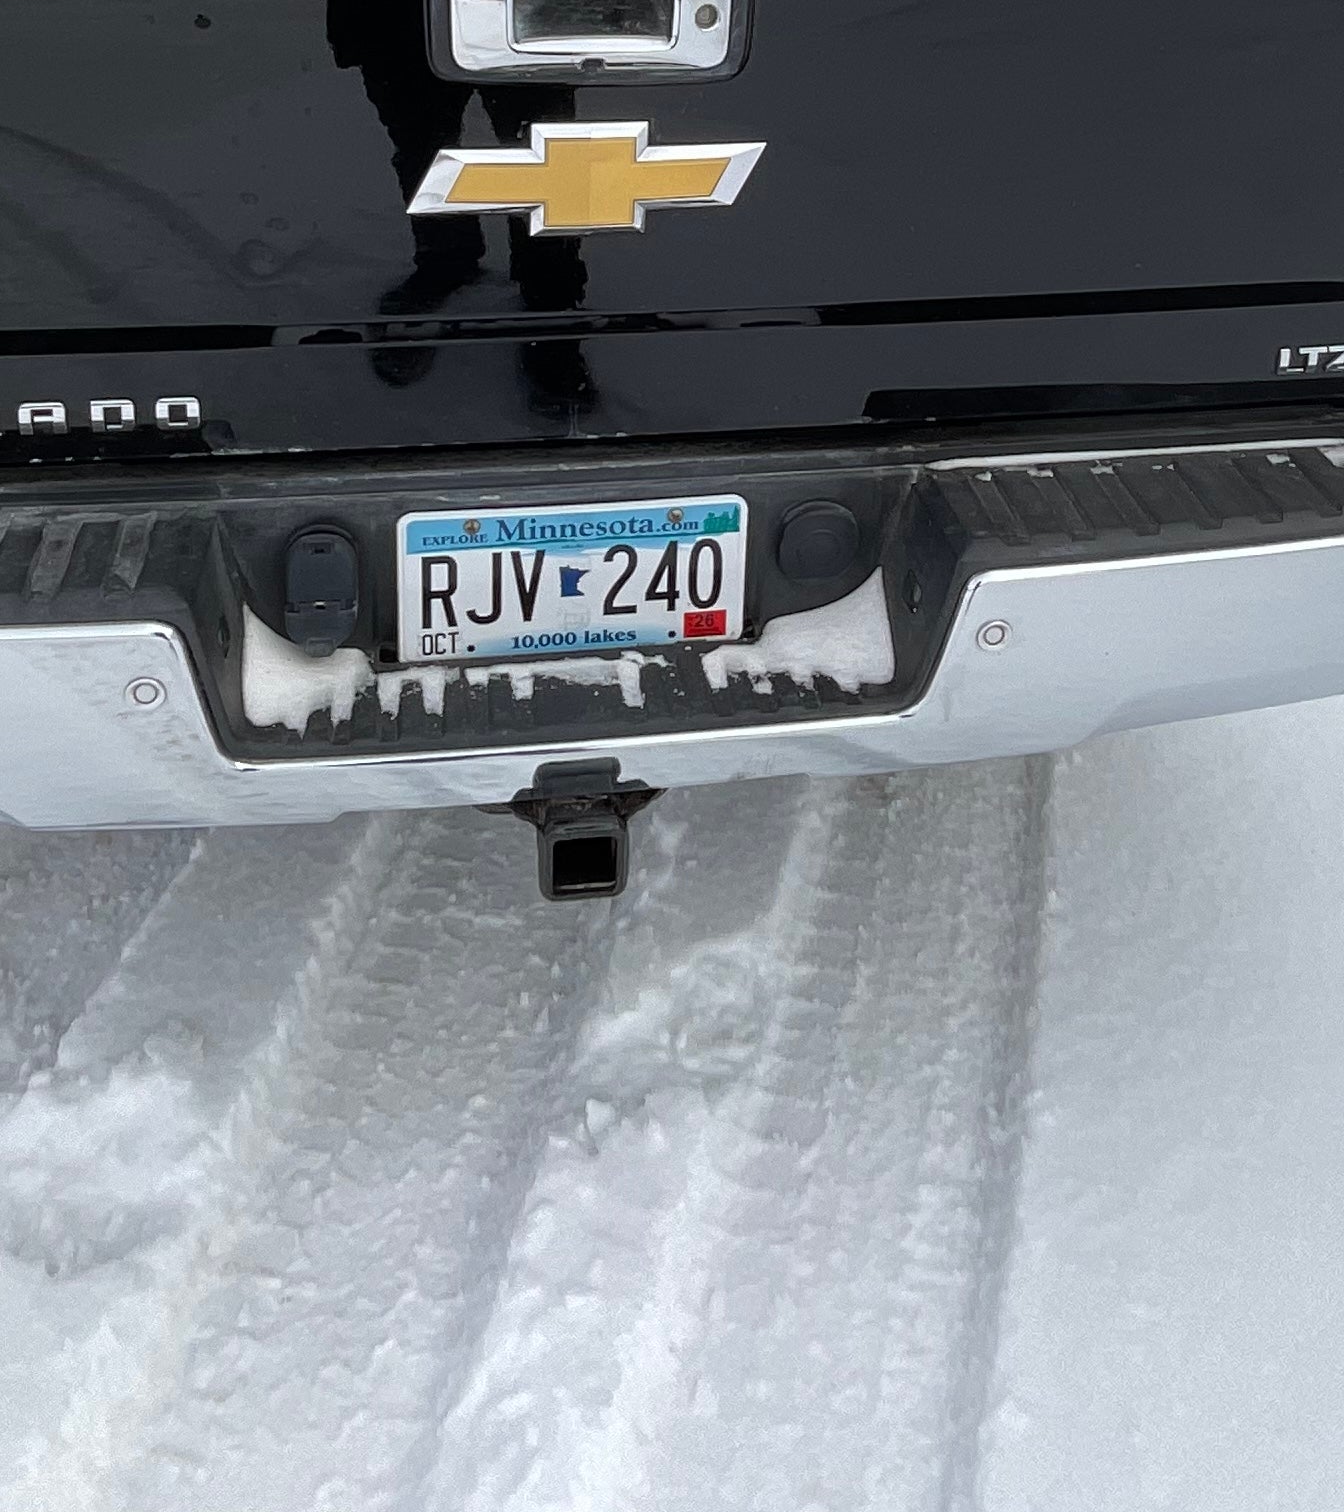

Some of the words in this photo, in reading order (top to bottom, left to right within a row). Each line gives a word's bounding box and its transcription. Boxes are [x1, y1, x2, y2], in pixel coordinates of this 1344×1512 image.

[422, 533, 489, 547] EXPLORE
[421, 549, 546, 629] RJV
[602, 538, 724, 616] 240
[694, 612, 716, 628] 26
[422, 631, 459, 656] OCT
[583, 628, 637, 644] lakes
